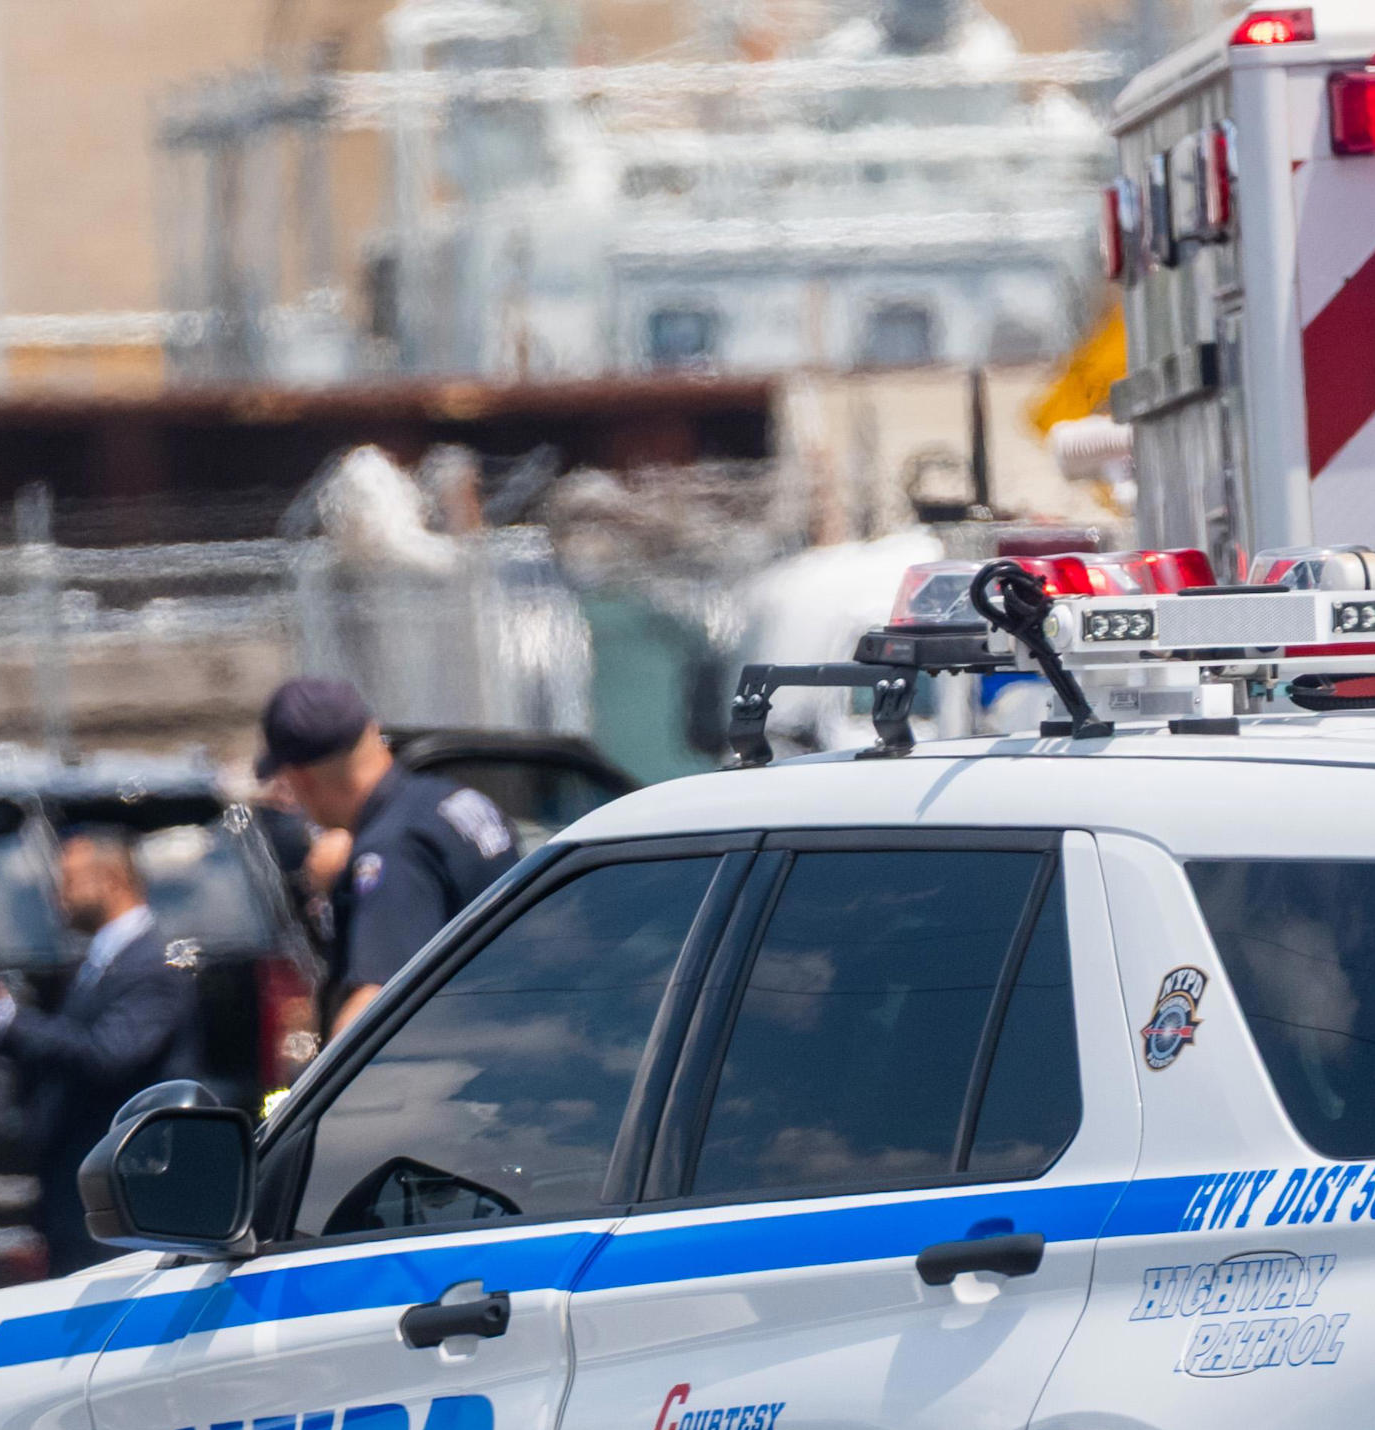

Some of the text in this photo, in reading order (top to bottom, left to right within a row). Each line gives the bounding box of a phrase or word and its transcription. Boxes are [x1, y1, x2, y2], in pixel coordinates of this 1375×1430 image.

[1177, 1169, 1279, 1232] HWY
[1265, 1164, 1367, 1226] DIST
[1129, 1253, 1337, 1321] HIGHWAY
[1173, 1313, 1351, 1373] PATROL
